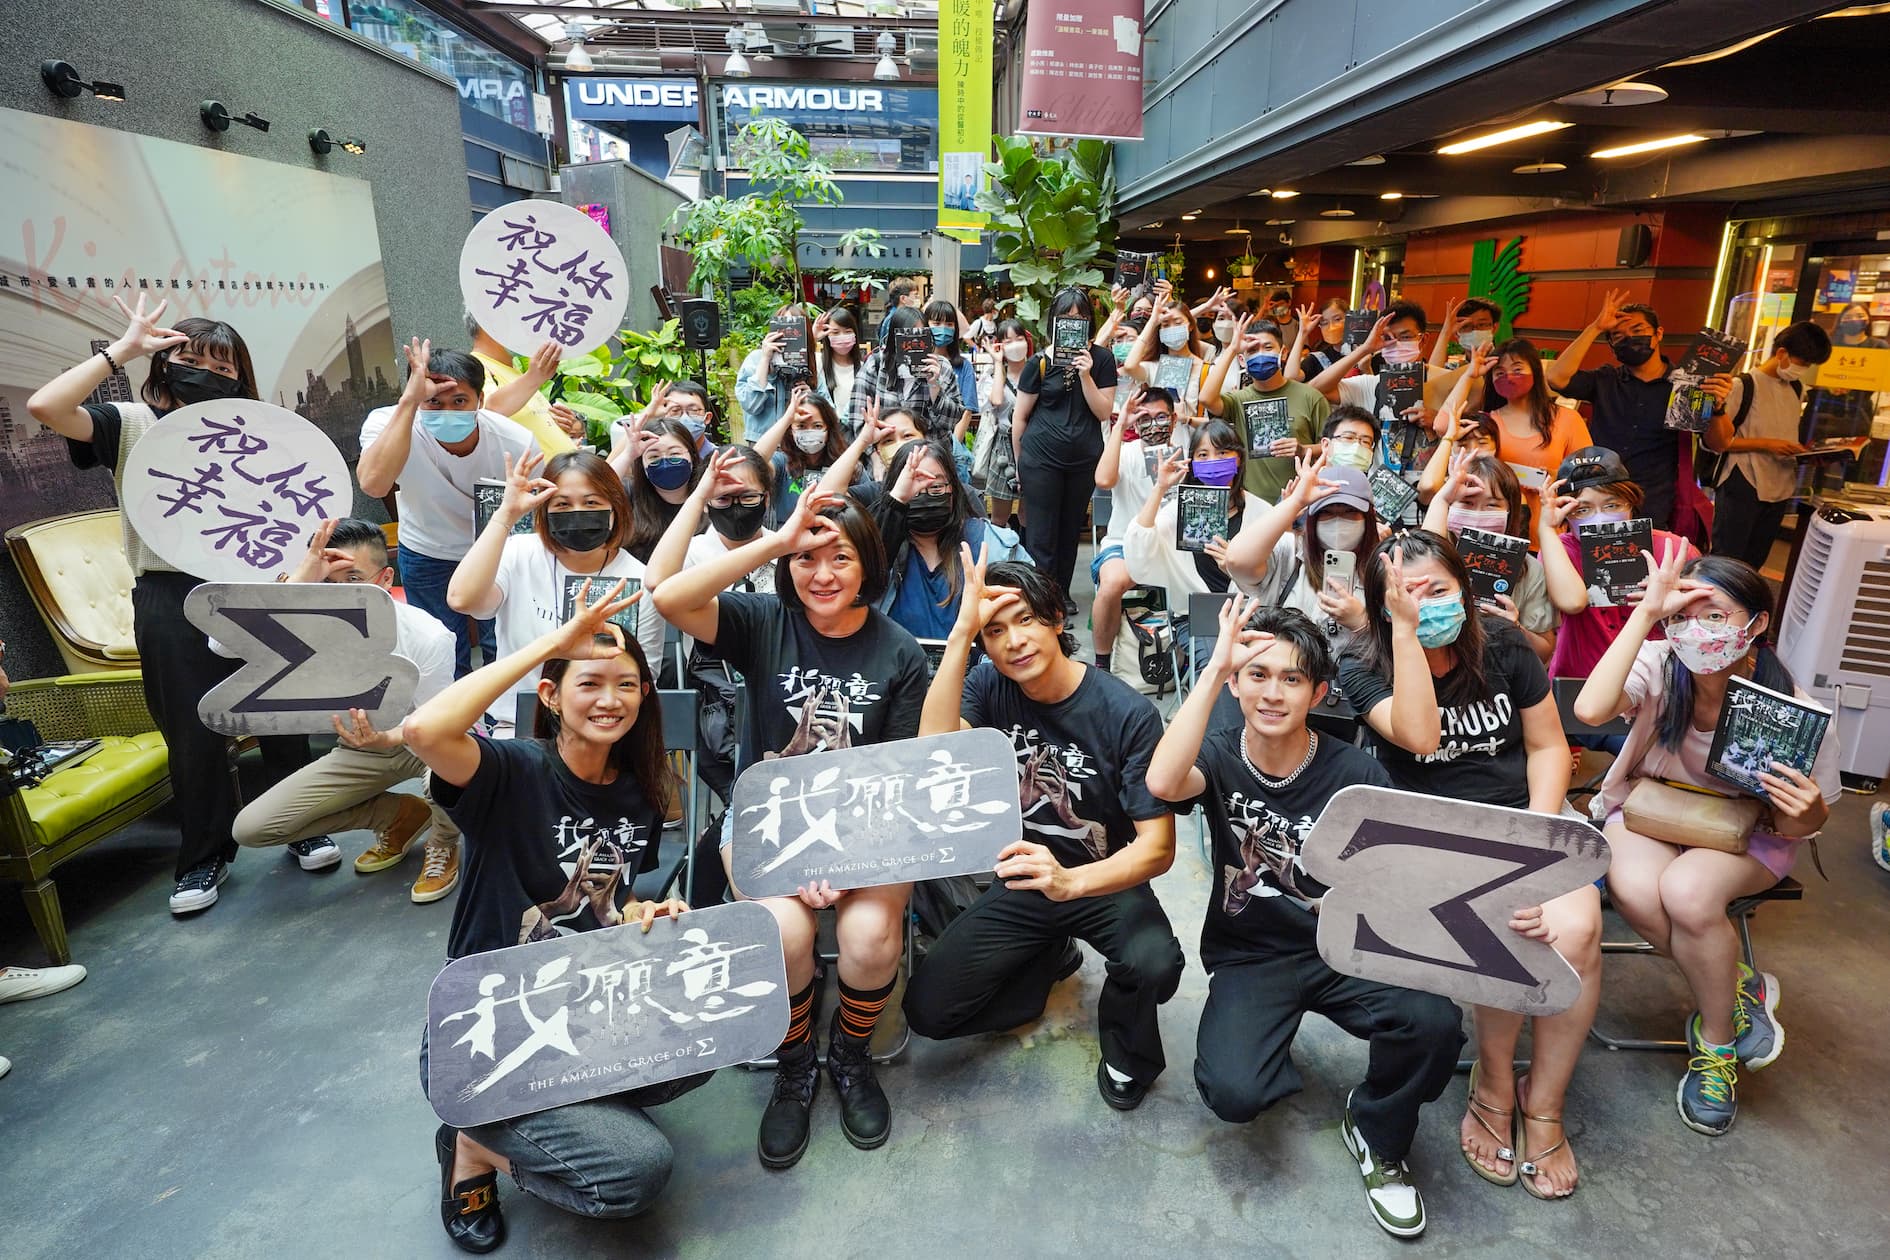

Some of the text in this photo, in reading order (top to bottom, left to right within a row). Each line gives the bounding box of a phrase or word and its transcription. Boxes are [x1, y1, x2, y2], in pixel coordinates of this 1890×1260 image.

[724, 86, 883, 111] ARMOUR
[497, 214, 614, 300] 祝你
[475, 258, 593, 346] 幸福
[188, 416, 334, 519] 祝你
[1569, 454, 1601, 467] TOKYO
[148, 462, 300, 569] 幸福
[740, 749, 1012, 880] 我願意
[804, 866, 824, 877] THE
[828, 861, 878, 874] AMAZING
[881, 855, 917, 867] GRACE
[920, 852, 936, 862] OF
[438, 927, 779, 1105] 我願意
[528, 1078, 556, 1093] THE
[560, 1061, 623, 1086] AMAZING
[628, 1052, 671, 1069] GRACE
[676, 1046, 693, 1058] OF
